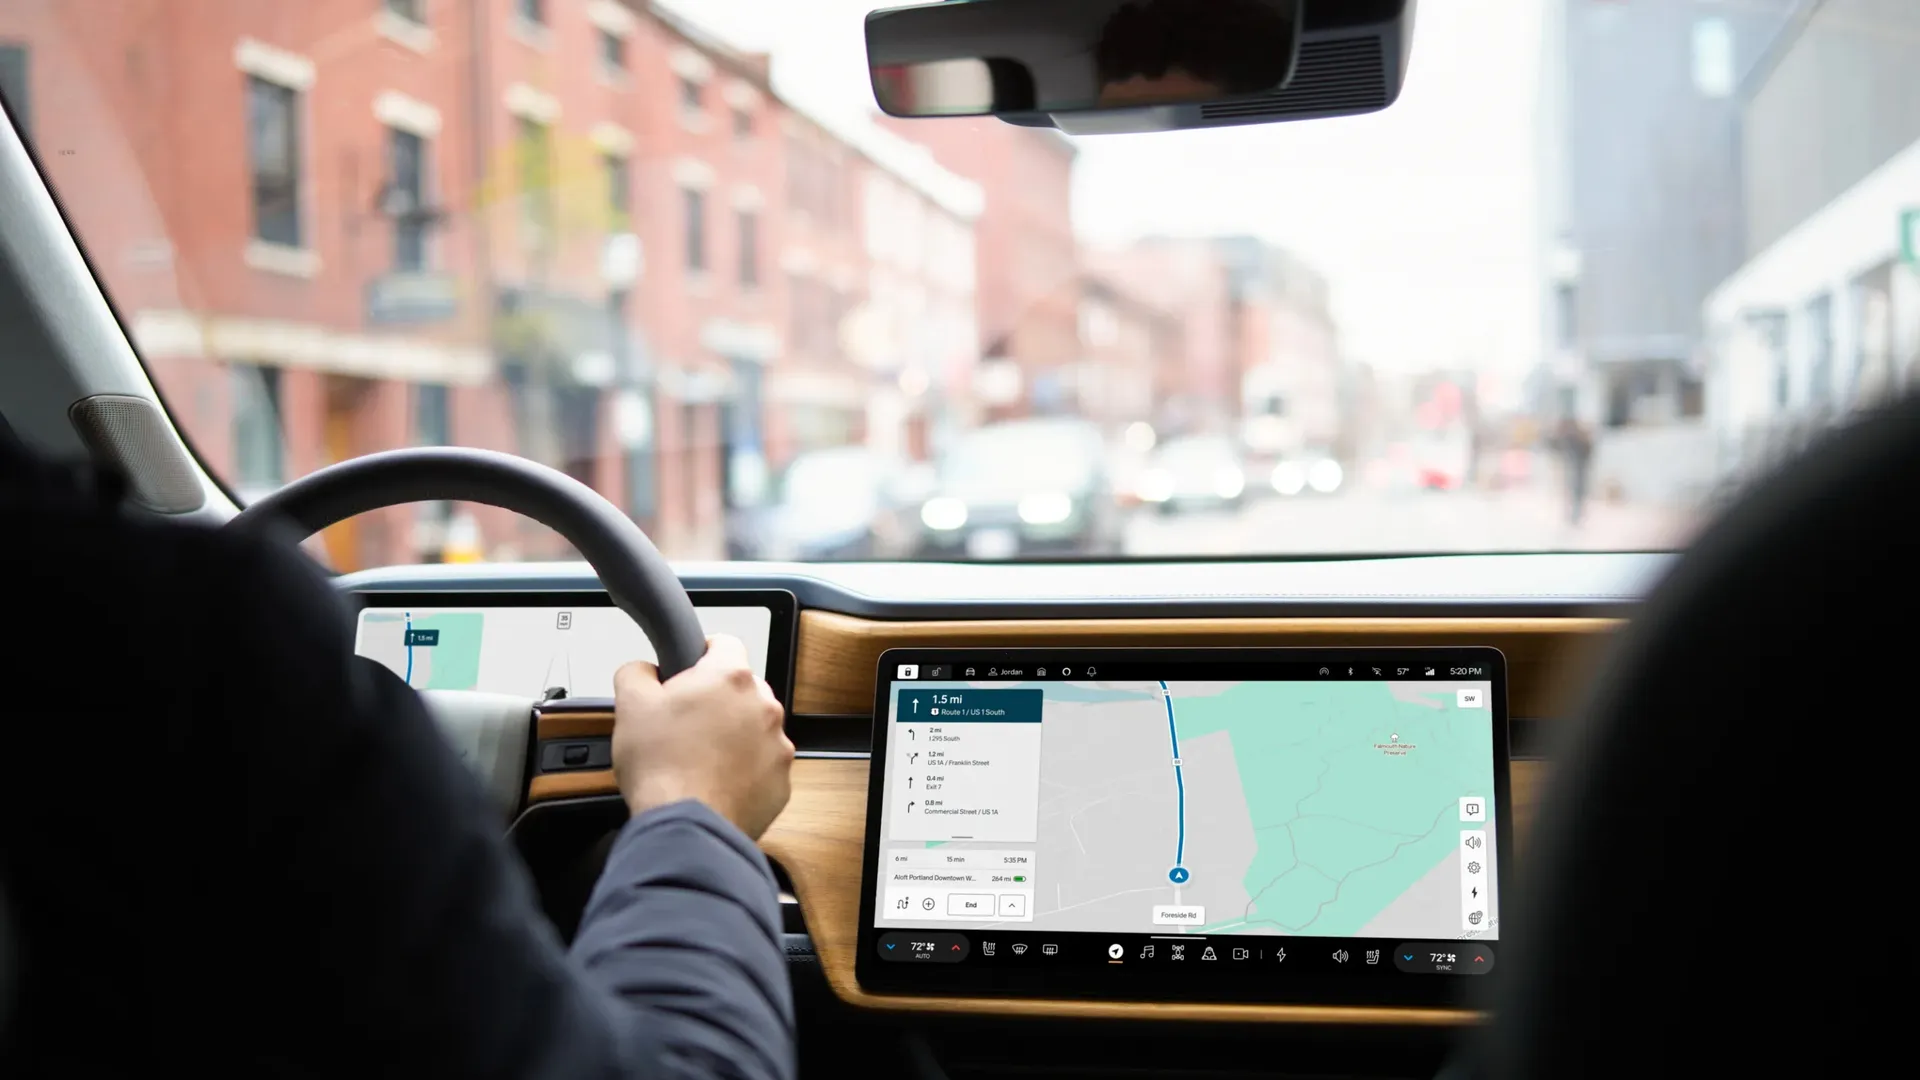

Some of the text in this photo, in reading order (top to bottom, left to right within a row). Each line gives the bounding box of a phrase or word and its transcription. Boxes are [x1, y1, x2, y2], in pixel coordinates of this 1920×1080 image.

[1001, 668, 1023, 676] Jordan
[1397, 667, 1410, 676] 57°
[1450, 667, 1482, 676] 5:20 PM
[932, 694, 963, 704] 1.5 mi
[910, 942, 926, 951] 72°
[1429, 953, 1446, 962] 72°
